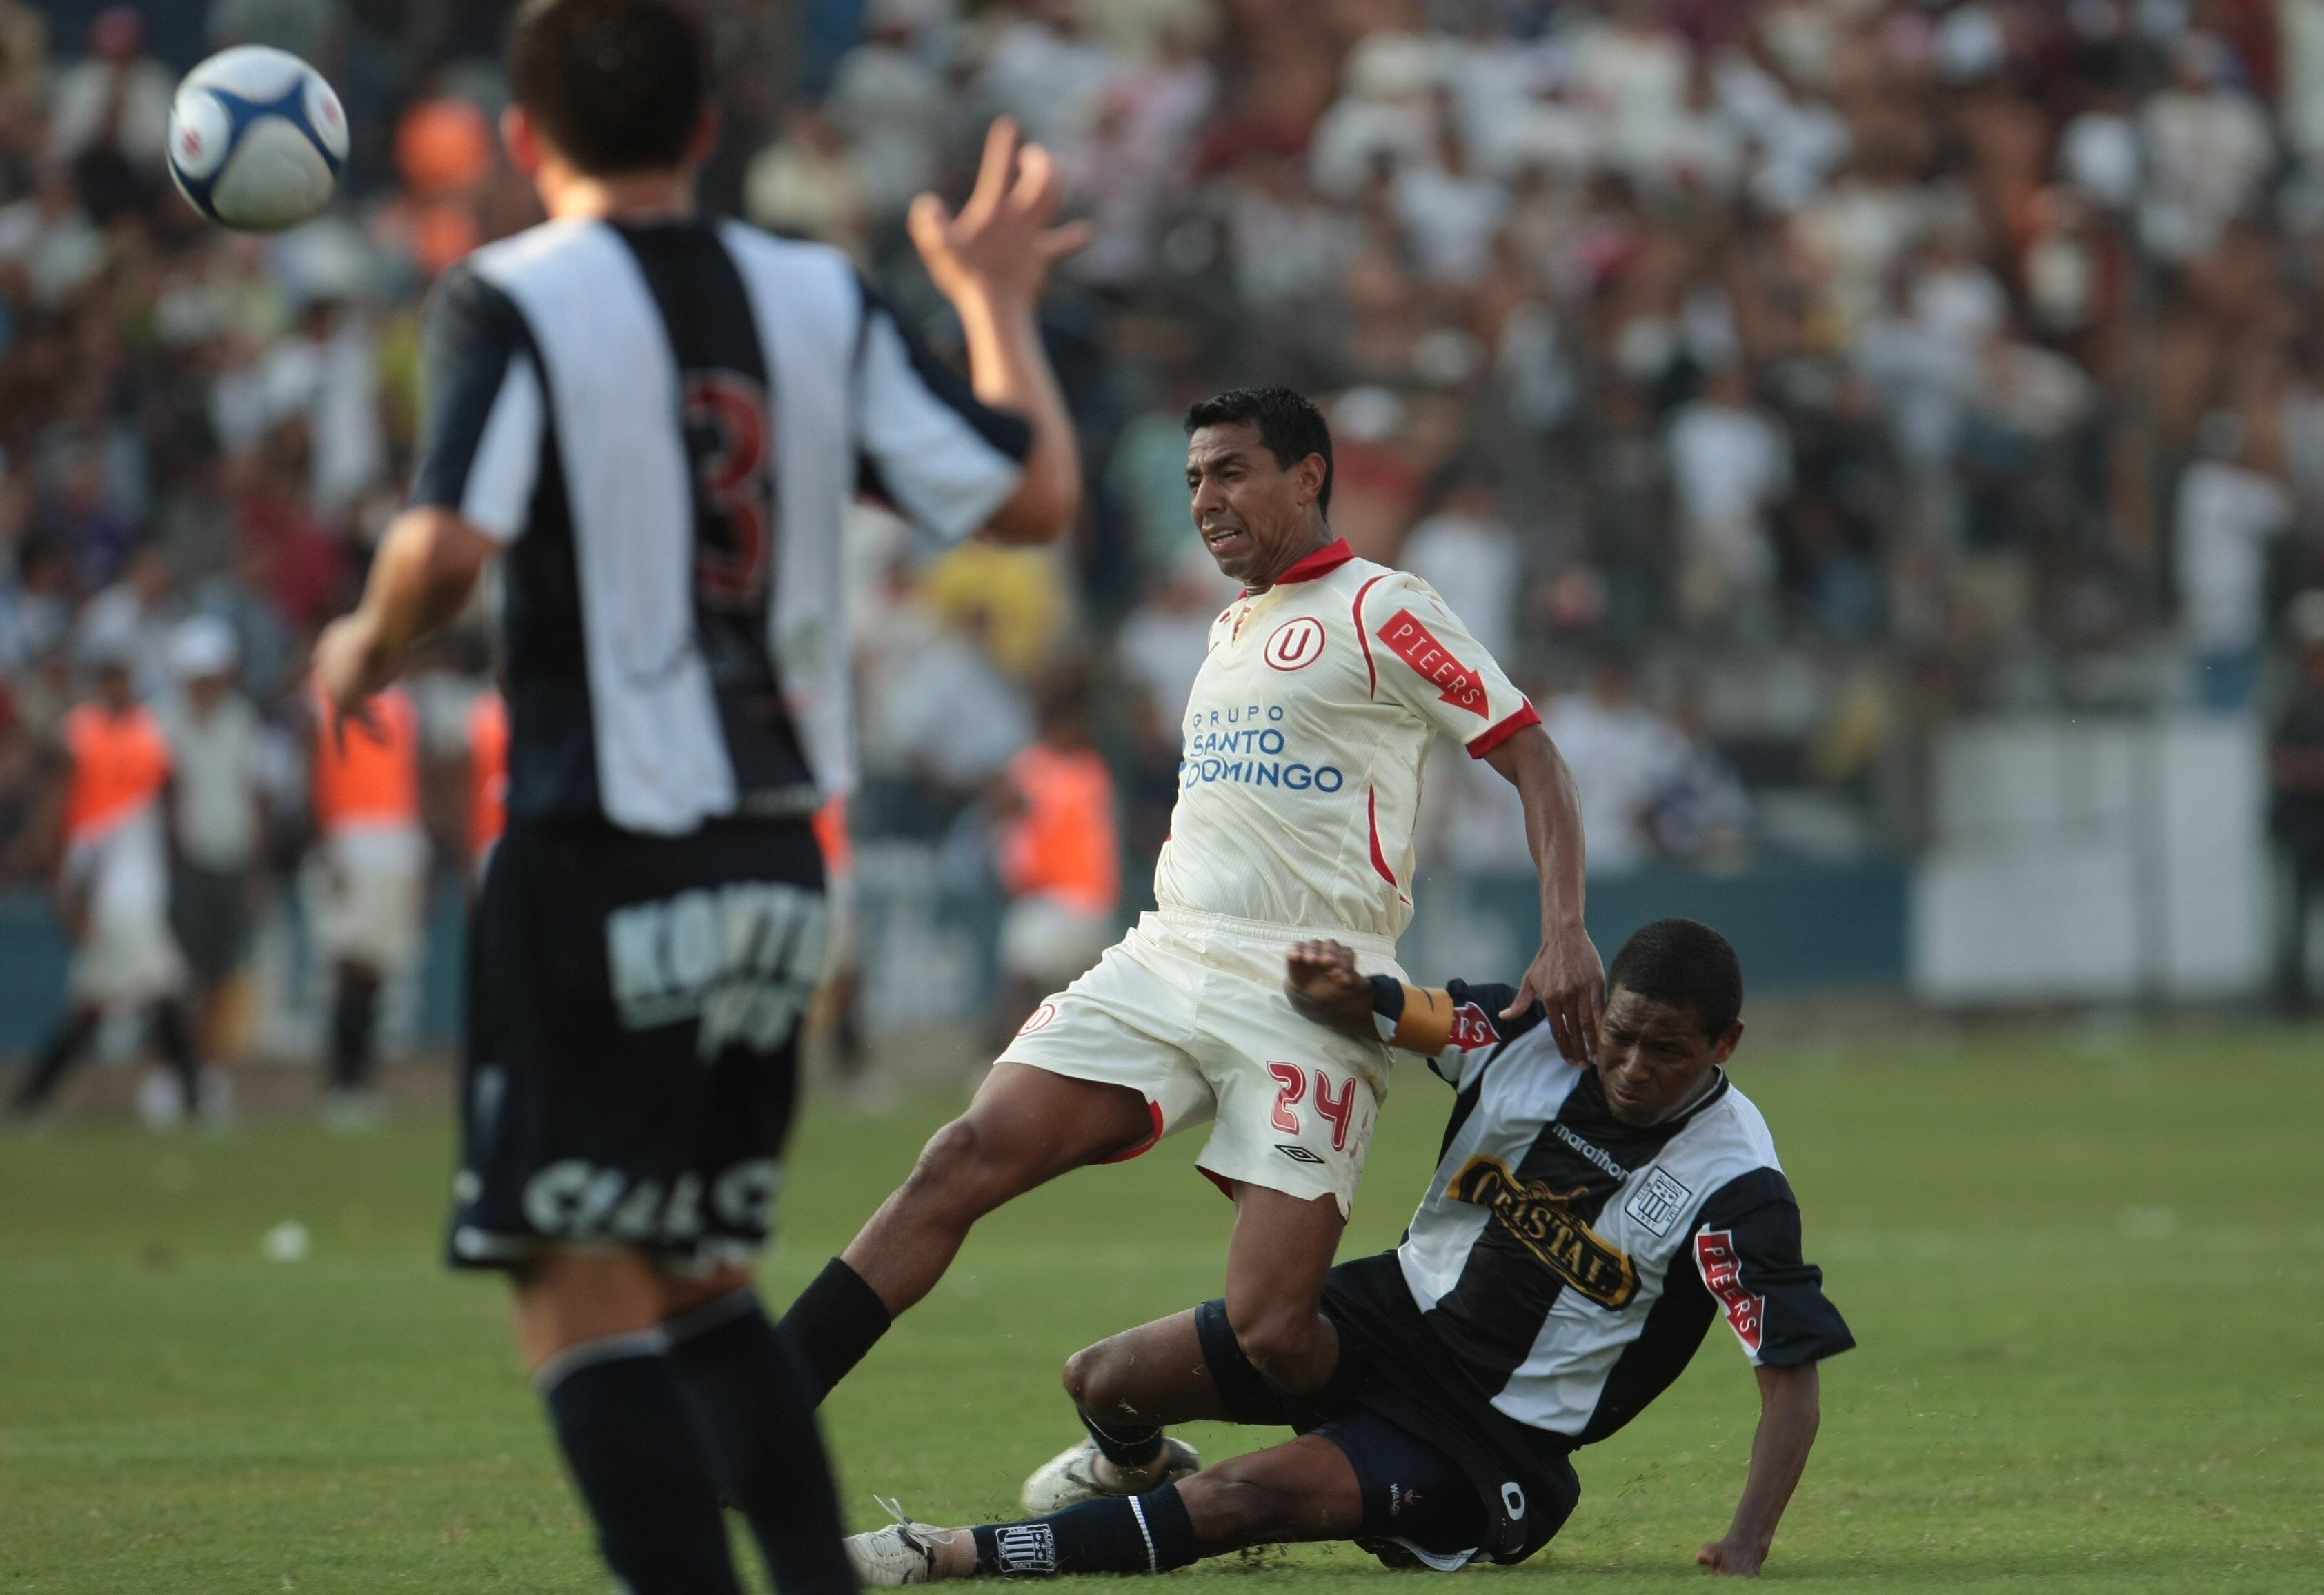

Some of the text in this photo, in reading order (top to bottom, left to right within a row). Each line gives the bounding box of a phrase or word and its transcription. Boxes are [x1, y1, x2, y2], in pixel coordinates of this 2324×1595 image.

[682, 370, 773, 611] 3
[1278, 628, 1311, 662] U
[1391, 623, 1480, 704] PIEERS
[1189, 728, 1285, 757] SANTO
[1193, 705, 1284, 729] GRUPO
[1185, 758, 1343, 793] DOMINGO
[1267, 1060, 1356, 1152] 24
[1704, 1246, 1758, 1333] PIEERS
